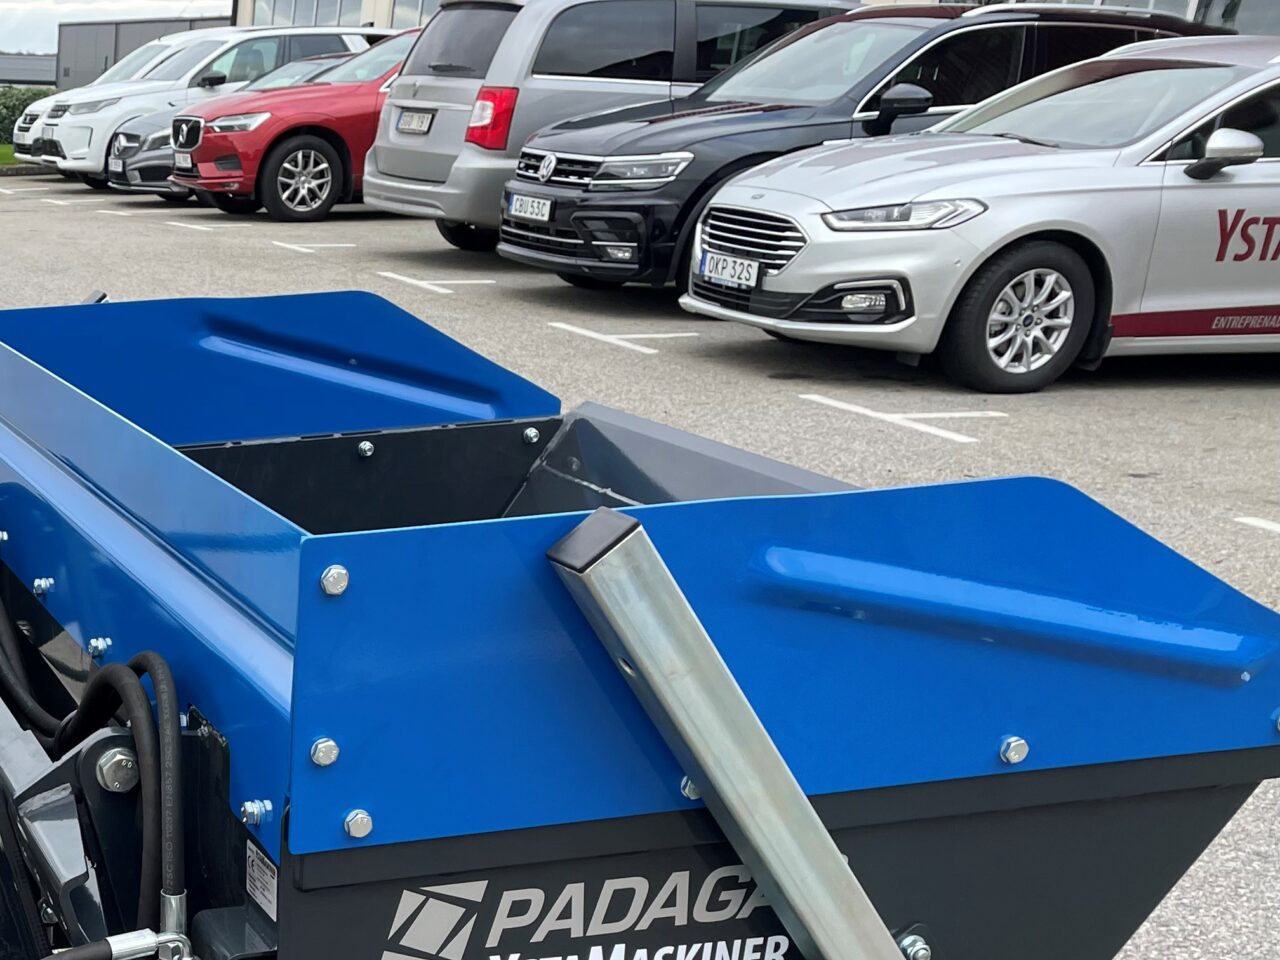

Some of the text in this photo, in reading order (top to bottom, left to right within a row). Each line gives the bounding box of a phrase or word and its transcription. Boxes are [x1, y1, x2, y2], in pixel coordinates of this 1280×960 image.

[513, 196, 547, 218] CBU 53C
[708, 256, 728, 276] OKP
[731, 259, 753, 282] 32S
